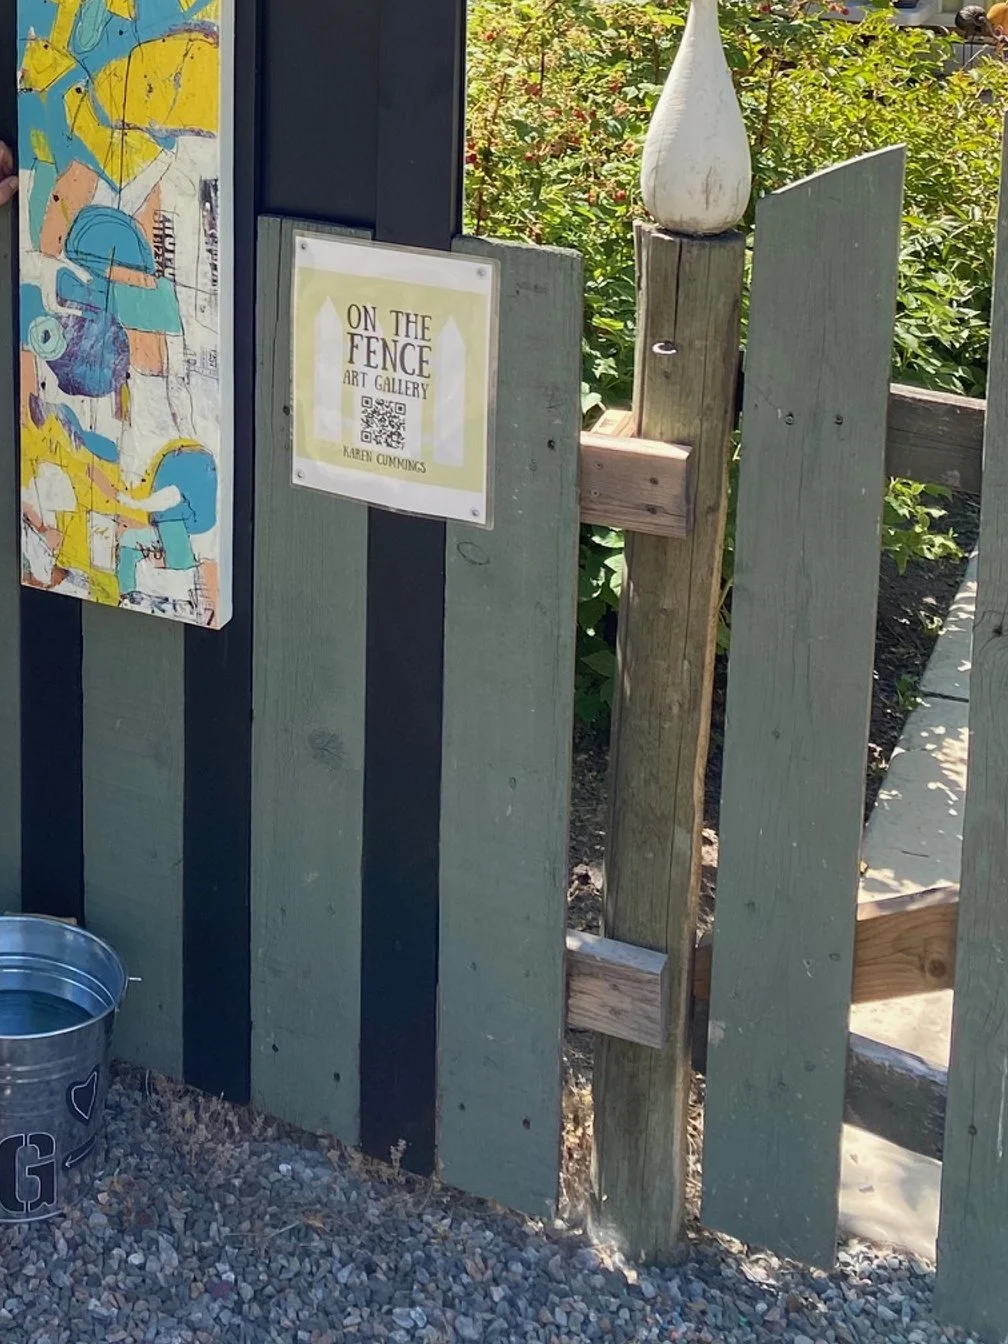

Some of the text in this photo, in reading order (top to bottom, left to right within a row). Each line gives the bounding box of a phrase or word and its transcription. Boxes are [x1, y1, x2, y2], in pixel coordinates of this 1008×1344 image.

[347, 304, 432, 341] ON THE
[347, 332, 431, 378] FENCE
[343, 370, 429, 399] ART GALLERY
[343, 447, 426, 473] KAREN CUMMINGS
